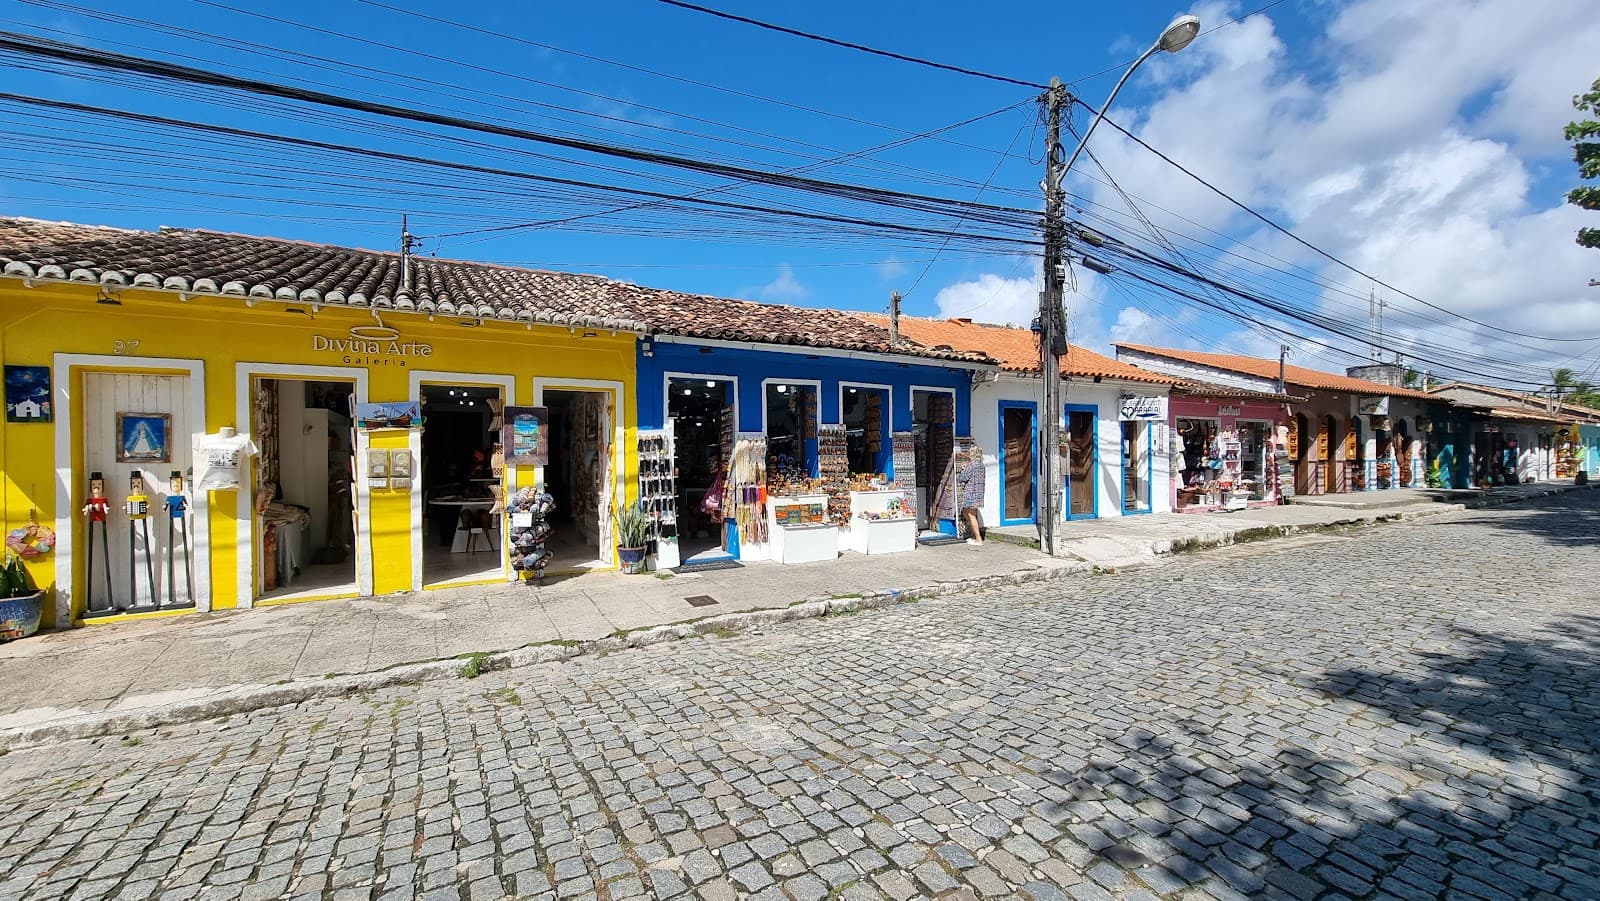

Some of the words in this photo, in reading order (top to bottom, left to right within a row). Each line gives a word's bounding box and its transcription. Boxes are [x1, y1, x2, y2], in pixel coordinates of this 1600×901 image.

[313, 335, 381, 355] Divina
[387, 340, 433, 358] Arte
[343, 356, 407, 367] Galeria
